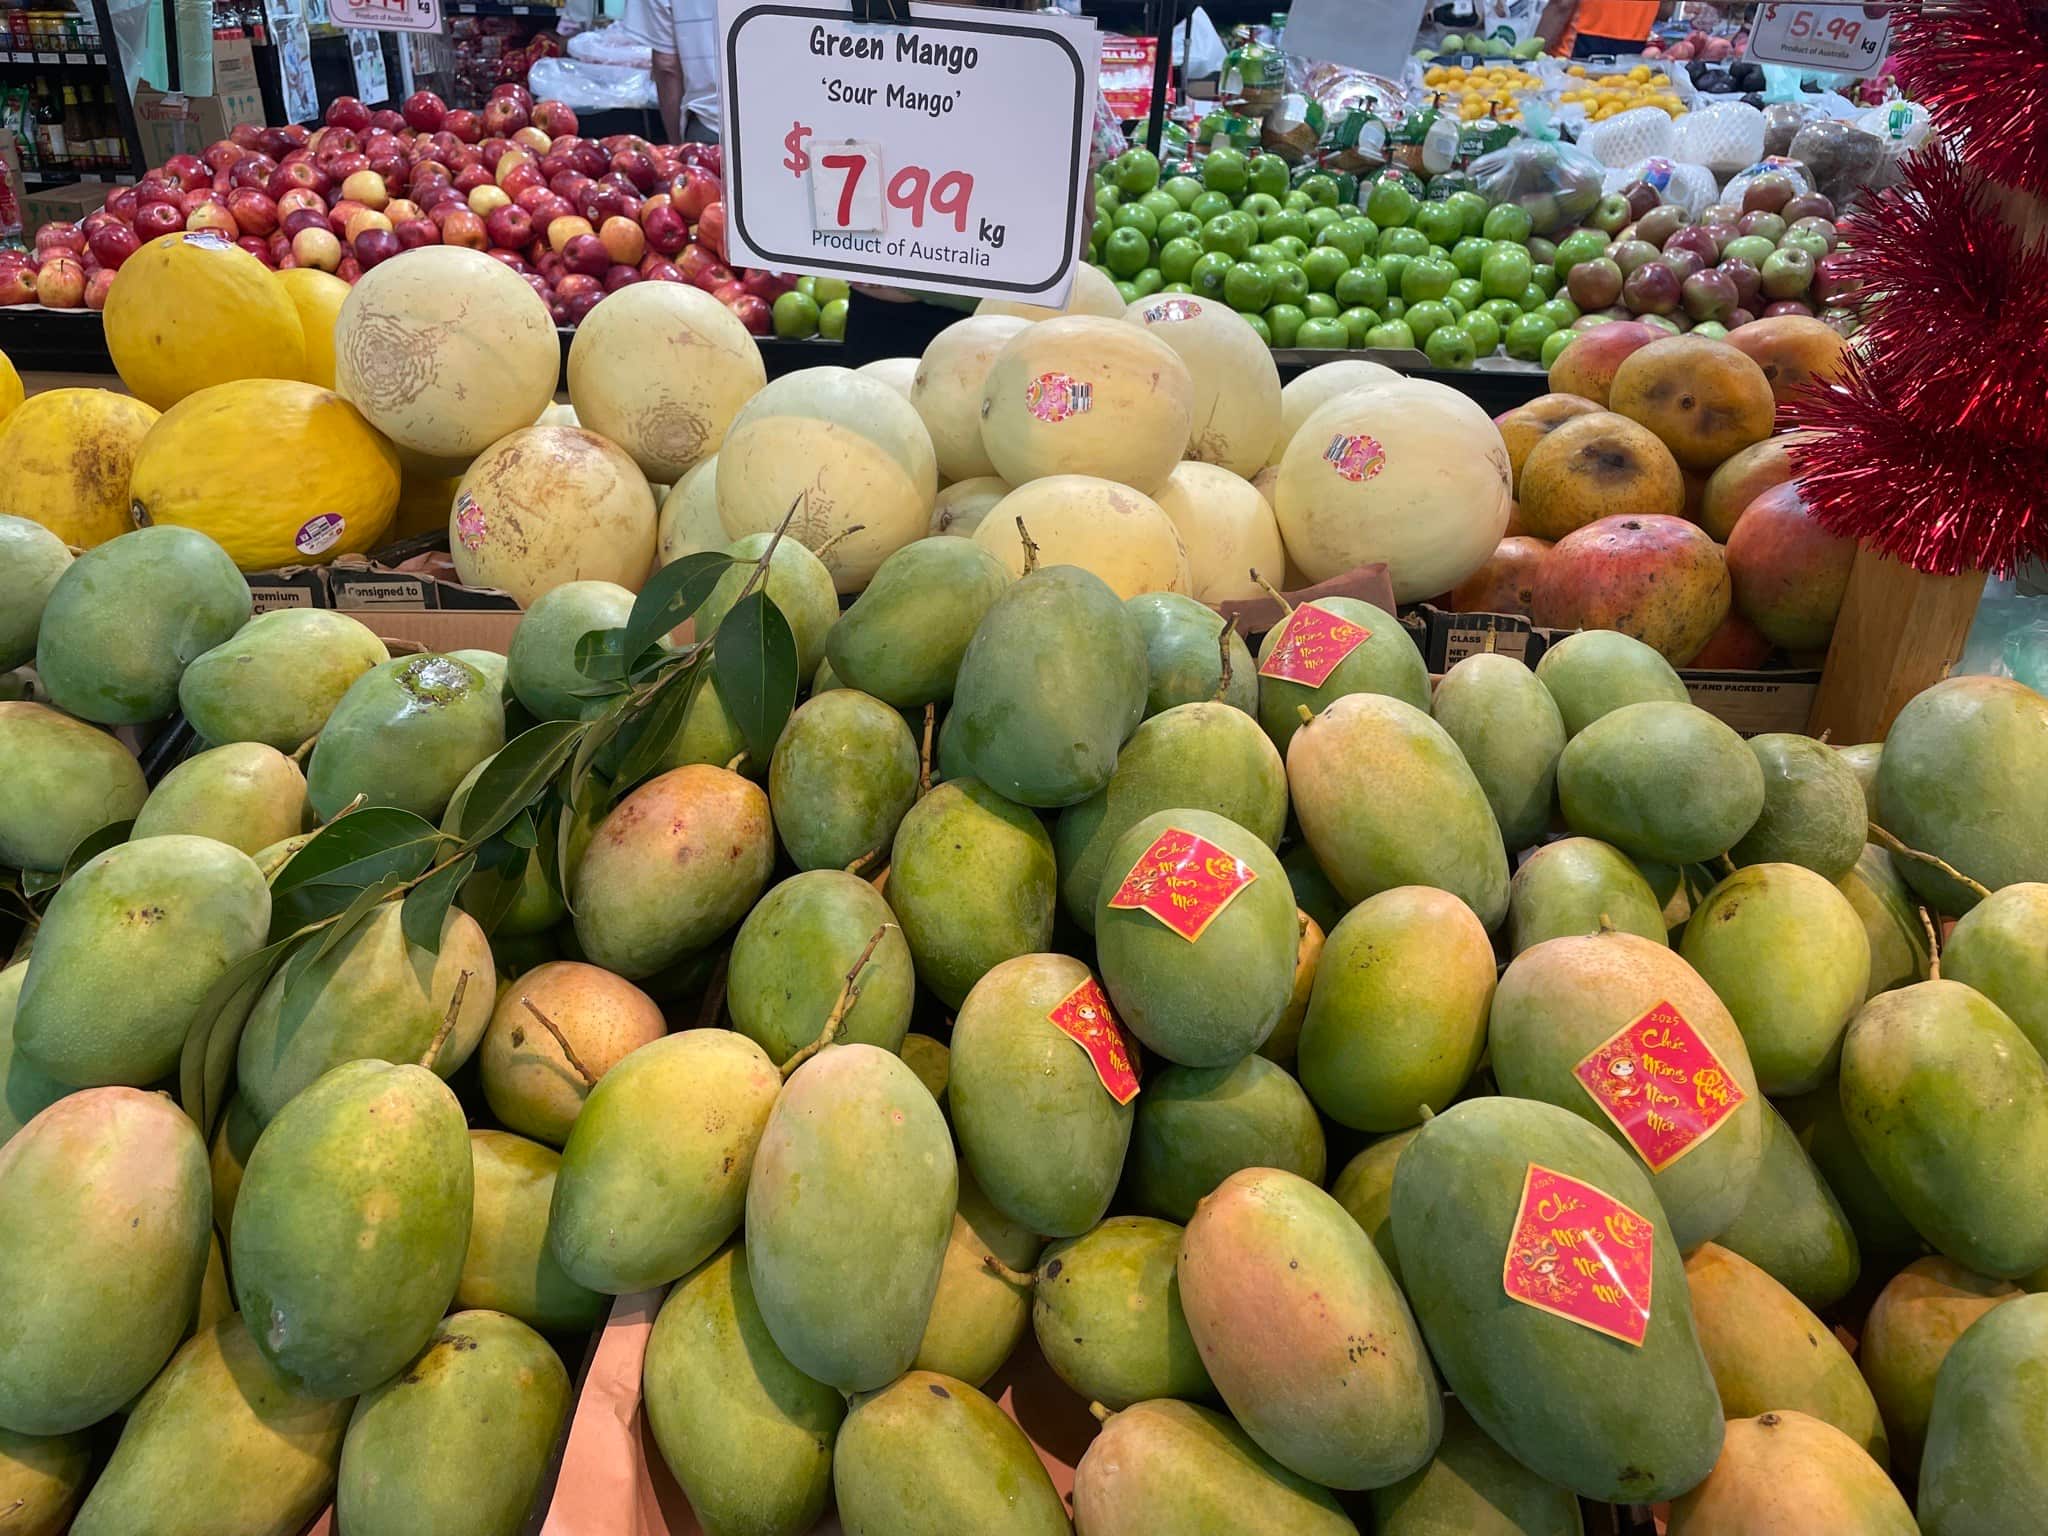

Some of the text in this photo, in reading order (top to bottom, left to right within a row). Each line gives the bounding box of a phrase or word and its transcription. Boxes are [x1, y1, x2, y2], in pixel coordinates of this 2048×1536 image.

[1790, 10, 1862, 45] 5.99
[1861, 37, 1877, 54] kg
[810, 25, 979, 74] Green Mango
[1781, 44, 1809, 55] Product
[1819, 48, 1850, 59] Australia
[979, 218, 1006, 248] kg
[812, 230, 991, 267] Product of Australia
[251, 591, 300, 602] remium
[406, 586, 418, 597] to
[1450, 635, 1481, 644] CLASS
[1448, 648, 1469, 657] NET
[1702, 683, 1723, 692] AND
[1724, 684, 1764, 693] PACKED
[1766, 685, 1781, 694] BY
[1650, 1013, 1681, 1026] 2025
